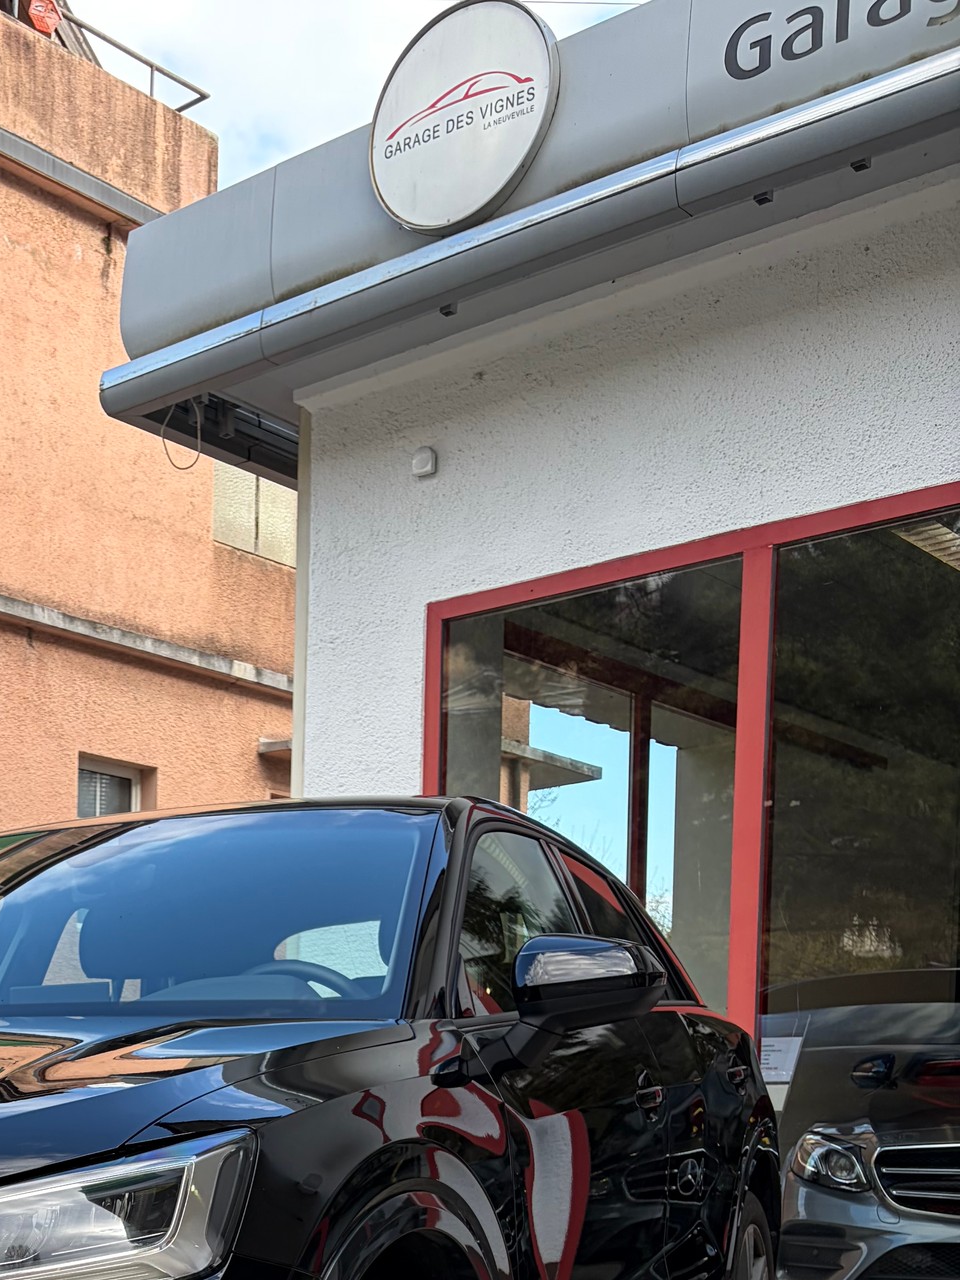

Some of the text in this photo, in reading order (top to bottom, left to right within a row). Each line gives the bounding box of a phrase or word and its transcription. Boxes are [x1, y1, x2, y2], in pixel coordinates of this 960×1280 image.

[724, 0, 960, 81] Gara
[383, 86, 536, 160] GARAGE DES VIGNES
[483, 104, 535, 130] LA NEUVEVILLE
